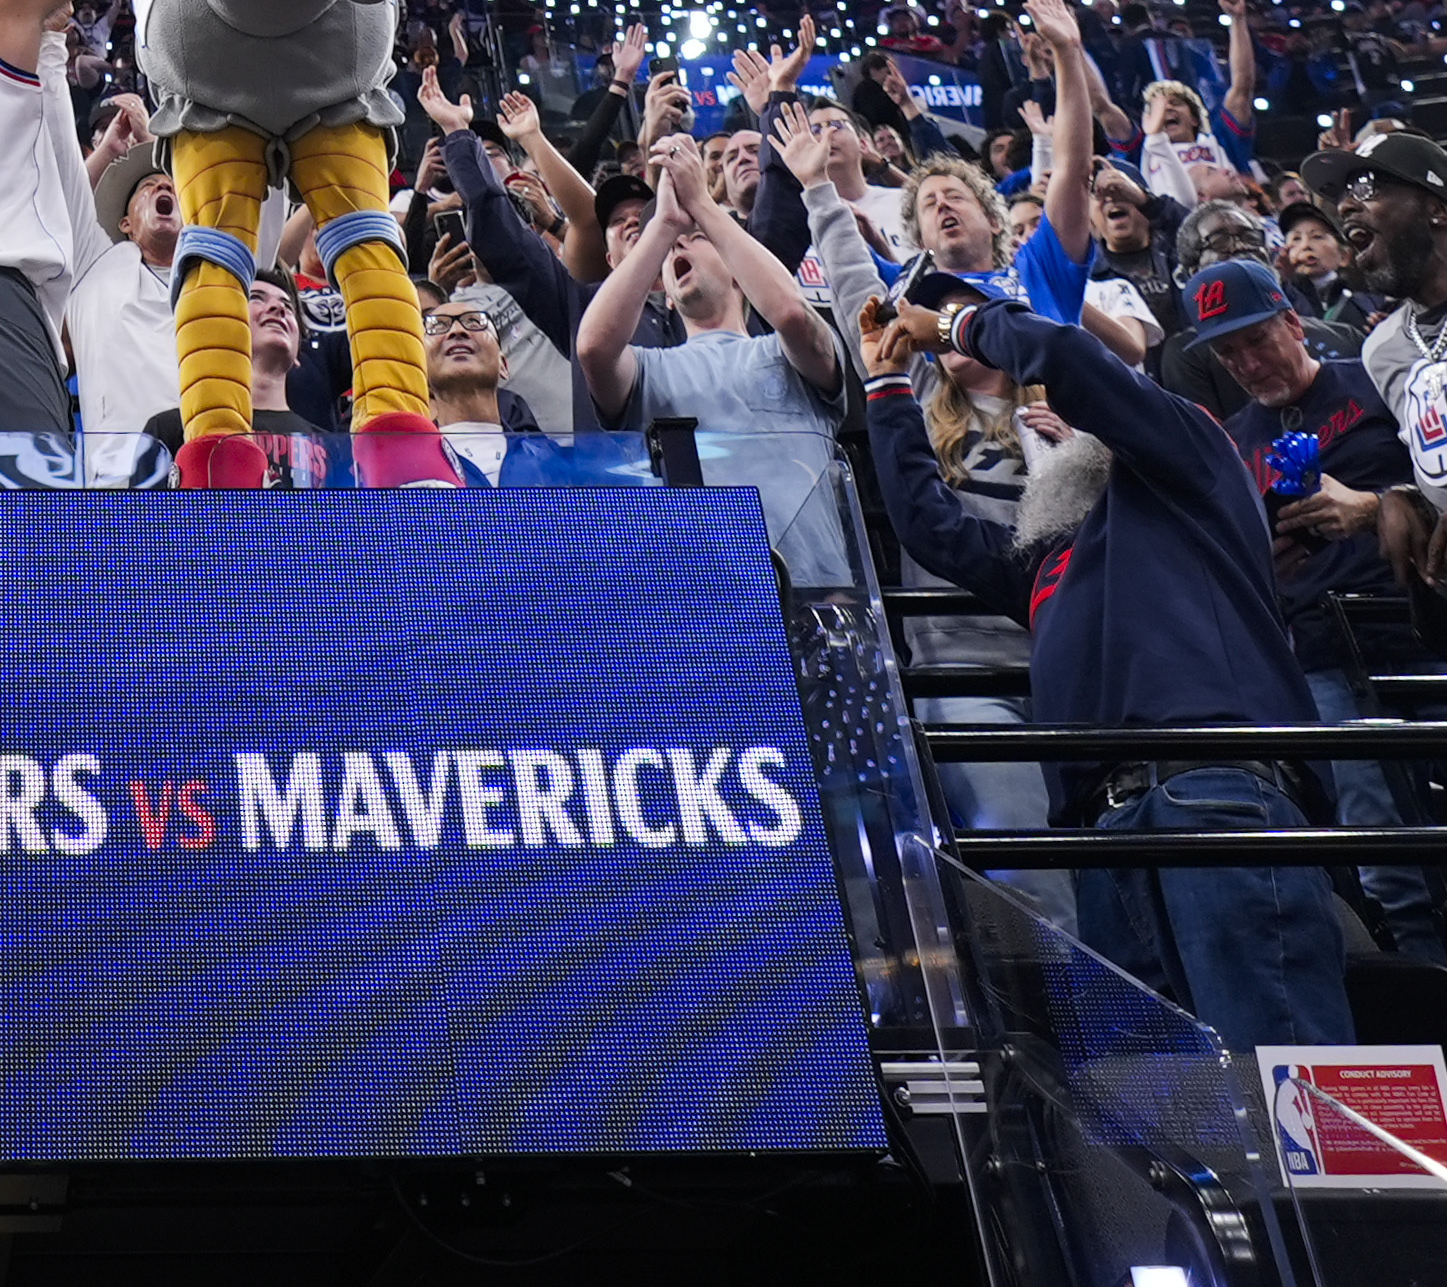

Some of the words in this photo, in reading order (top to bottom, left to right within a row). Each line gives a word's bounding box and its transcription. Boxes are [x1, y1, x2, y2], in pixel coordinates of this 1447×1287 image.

[128, 777, 219, 852] VS
[236, 744, 806, 855] MAVERICKS
[1339, 1069, 1375, 1079] CONDUCT
[1376, 1069, 1412, 1079] ADVISORY
[1287, 1150, 1310, 1171] NBA
